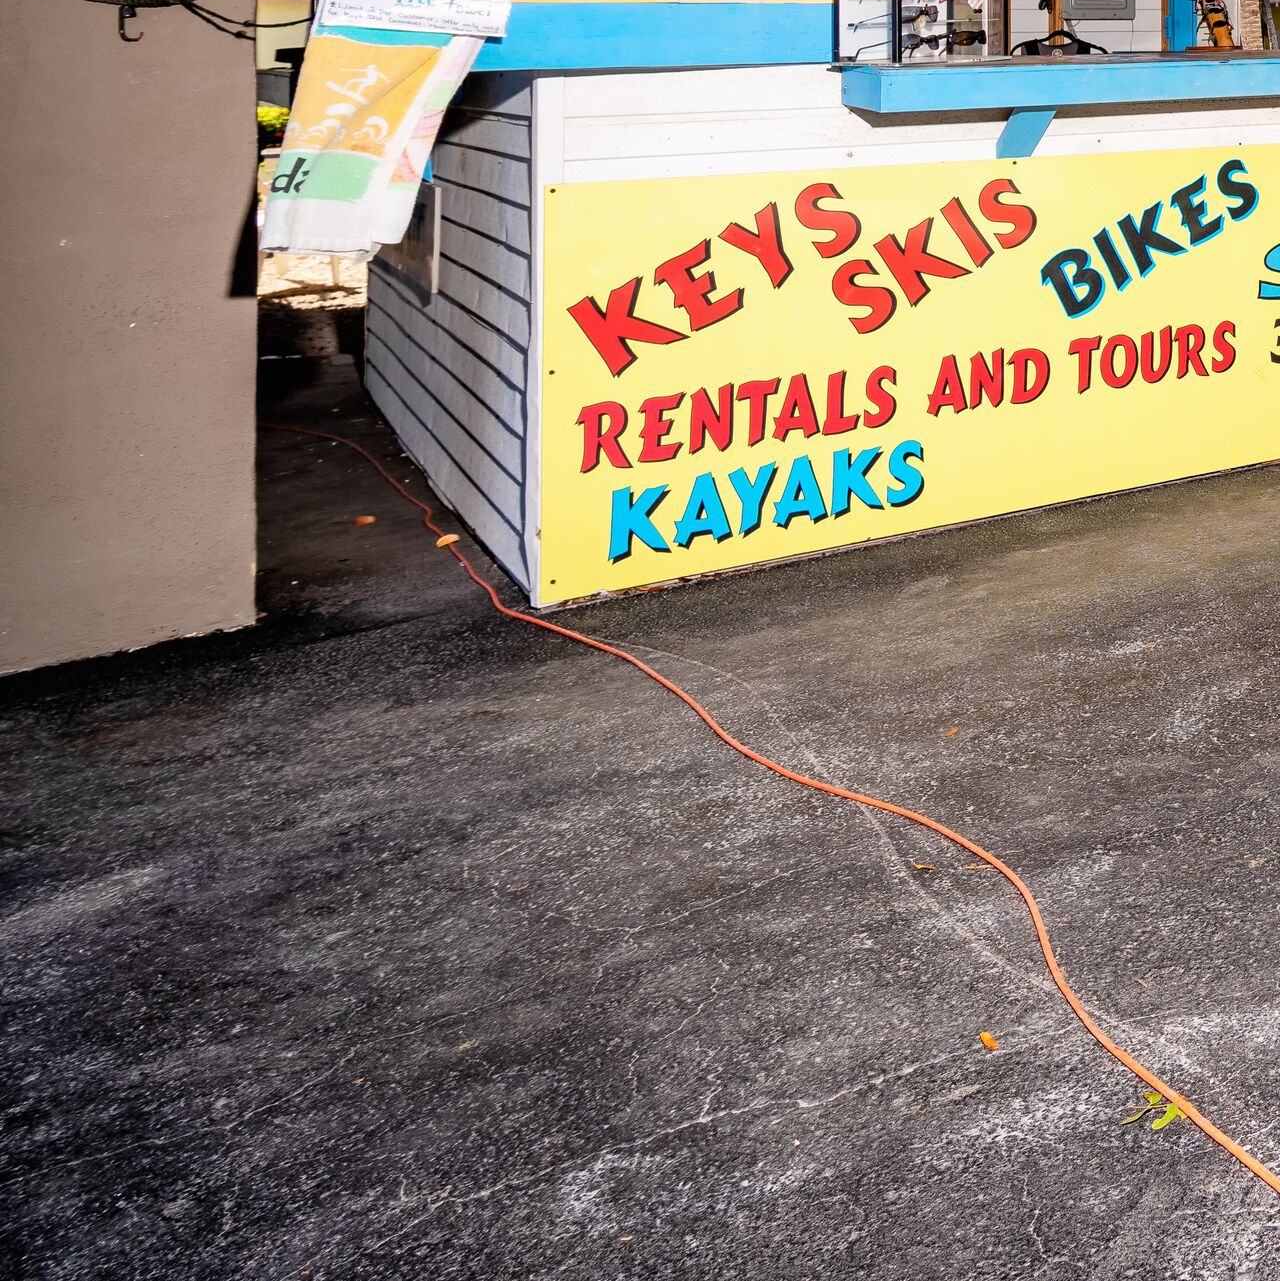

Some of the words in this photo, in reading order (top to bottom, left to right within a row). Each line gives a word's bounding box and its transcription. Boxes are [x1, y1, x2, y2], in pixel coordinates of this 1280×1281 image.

[566, 182, 862, 378] KEYS
[831, 178, 1038, 334] SKIS
[1039, 157, 1260, 320] BIKES
[575, 365, 898, 474] RENTALS
[926, 347, 1050, 418] AND
[1068, 320, 1237, 396] TOURS
[608, 440, 925, 563] KAYAKS
